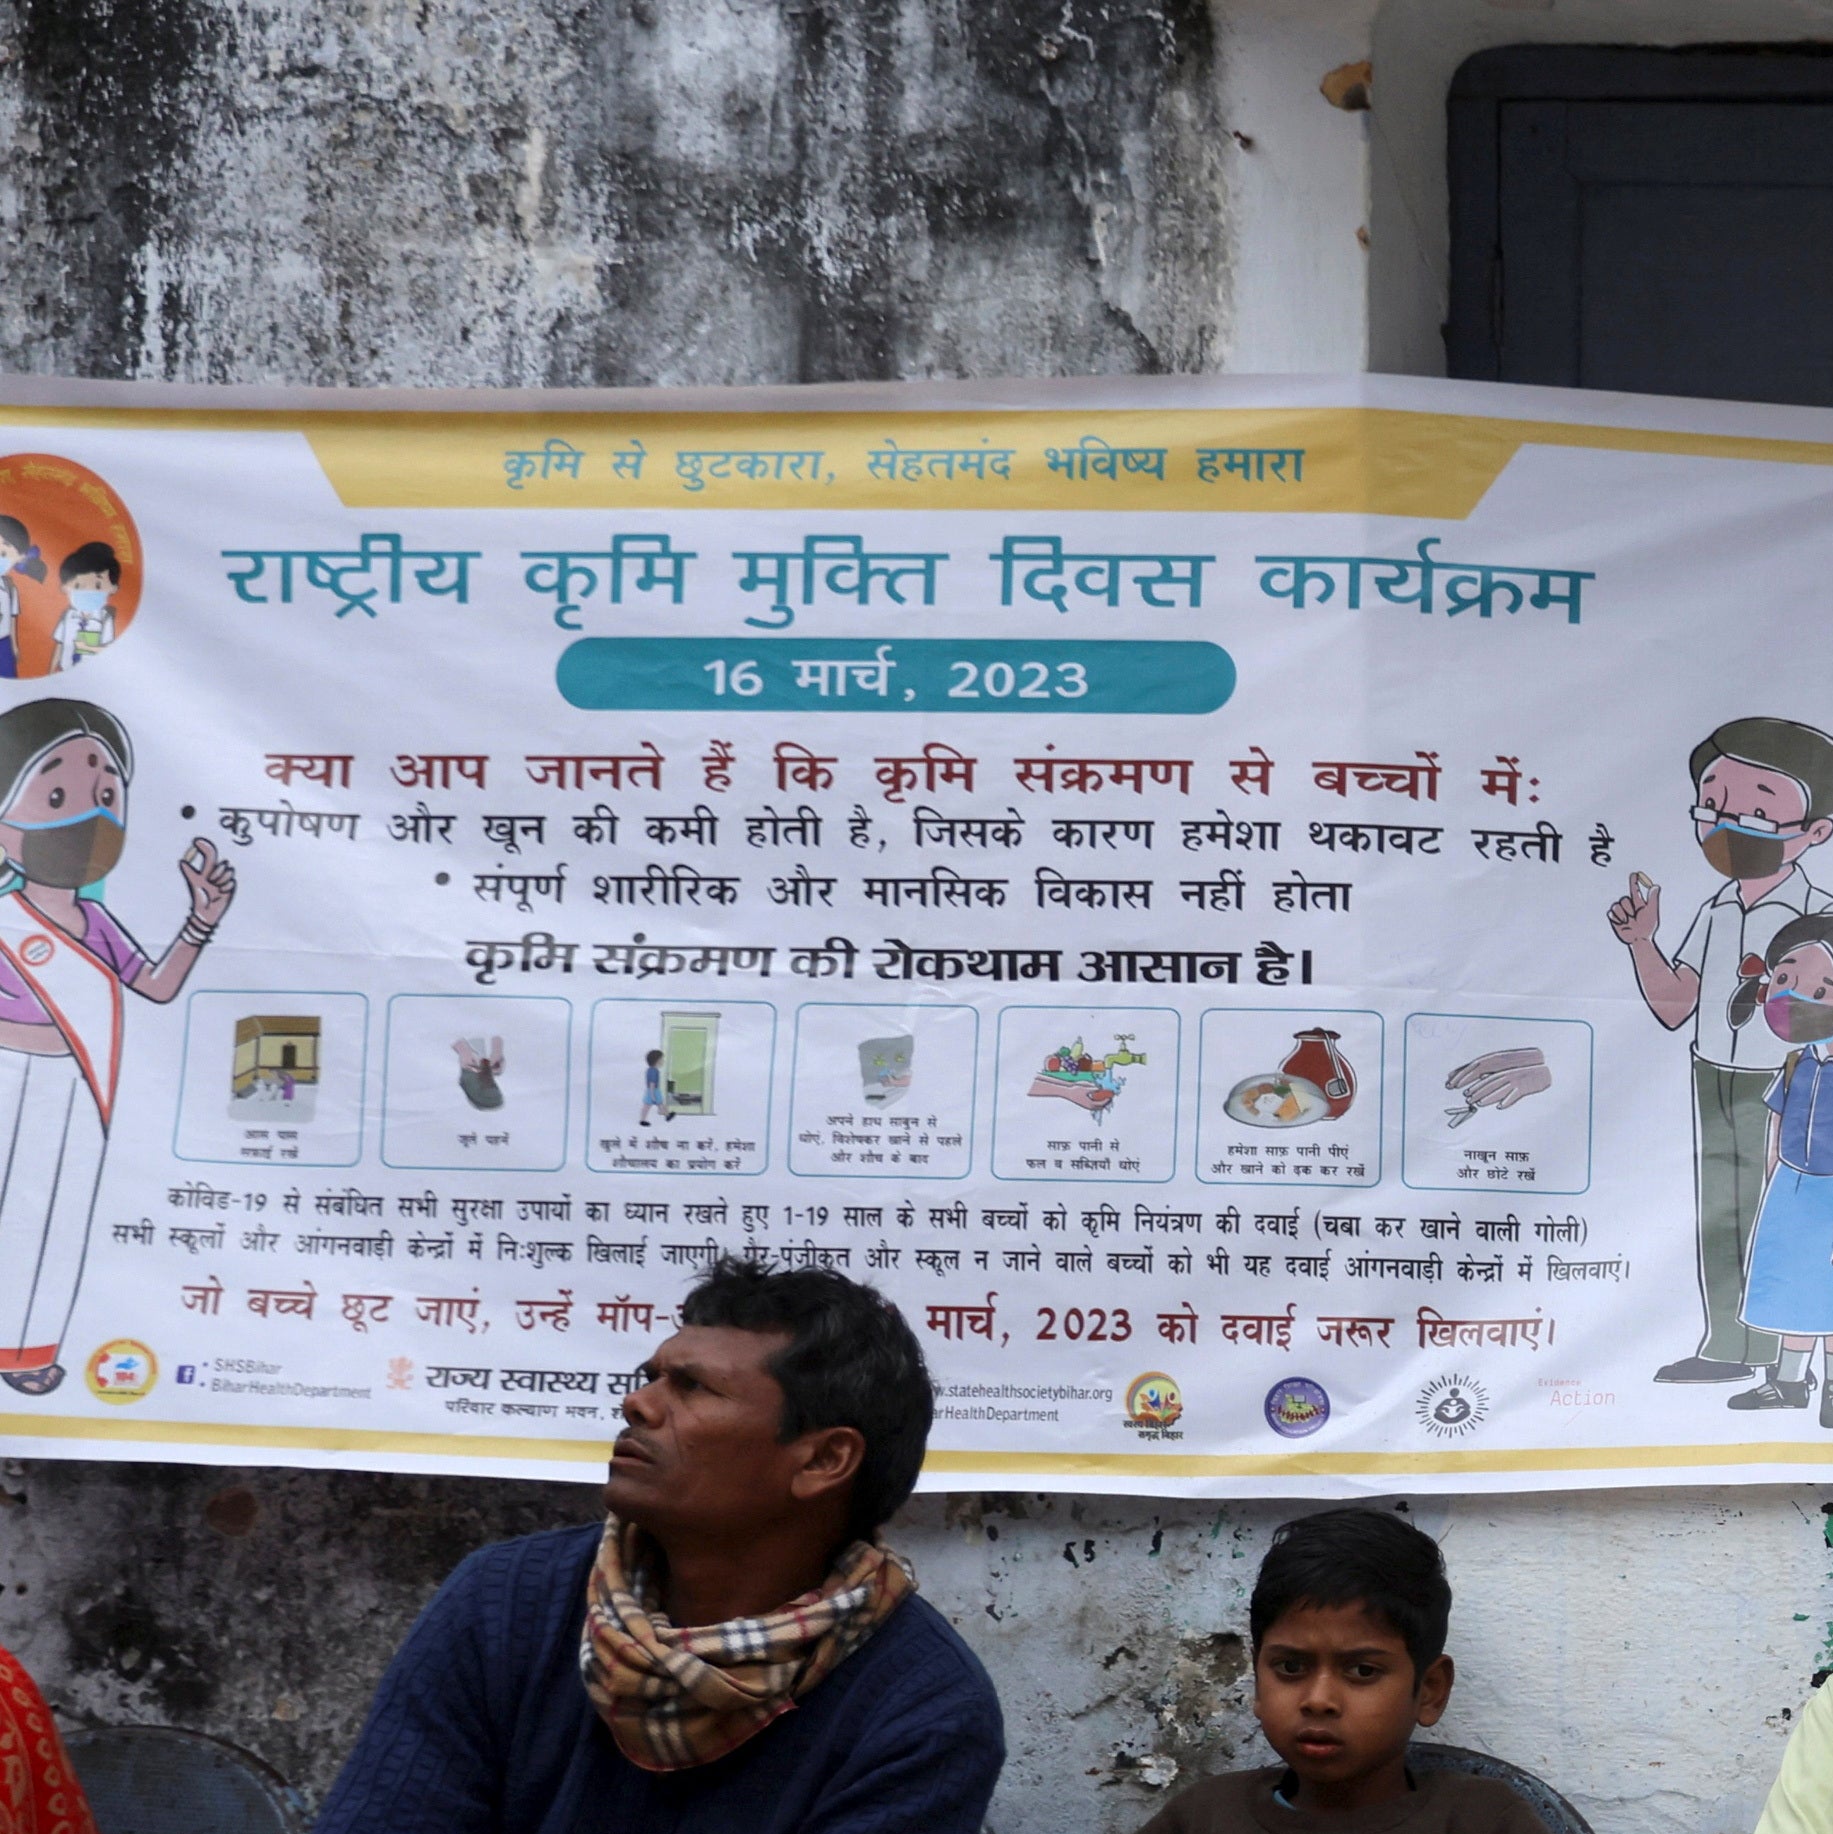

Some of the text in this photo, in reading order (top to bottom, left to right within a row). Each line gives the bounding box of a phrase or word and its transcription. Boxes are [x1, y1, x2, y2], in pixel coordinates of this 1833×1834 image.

[505, 435, 1306, 492] कृमि से छुटकारा, सेहतमंद भविष्य हमारा
[221, 533, 1596, 631] राष्ट्रीय कृमि मुक्ति दिवस कार्यक्रम
[704, 645, 1088, 701] 16 मार्च, 2023
[265, 740, 1539, 806] क्या आप जानते हैं कि कृमि संक्रमण से बच्चों में:
[219, 800, 1615, 867] कुपोषण और खून की कमी होती है, जिसके कारण हमेशा थकावट रहती है
[473, 863, 1353, 913] संपूर्ण शारीरिक और मानसिक विकास नहीं होता
[465, 932, 1312, 986] कृमि संक्रमण की रोकथाम आसान है।
[182, 1275, 574, 1334] जो बच्चे छूट जाएं, उन्हें
[926, 1291, 1554, 1352] मार्च, 2023 को दवाई जरूर खिलवाएं।
[425, 1366, 600, 1396] राज्य स्वास्थ्य
